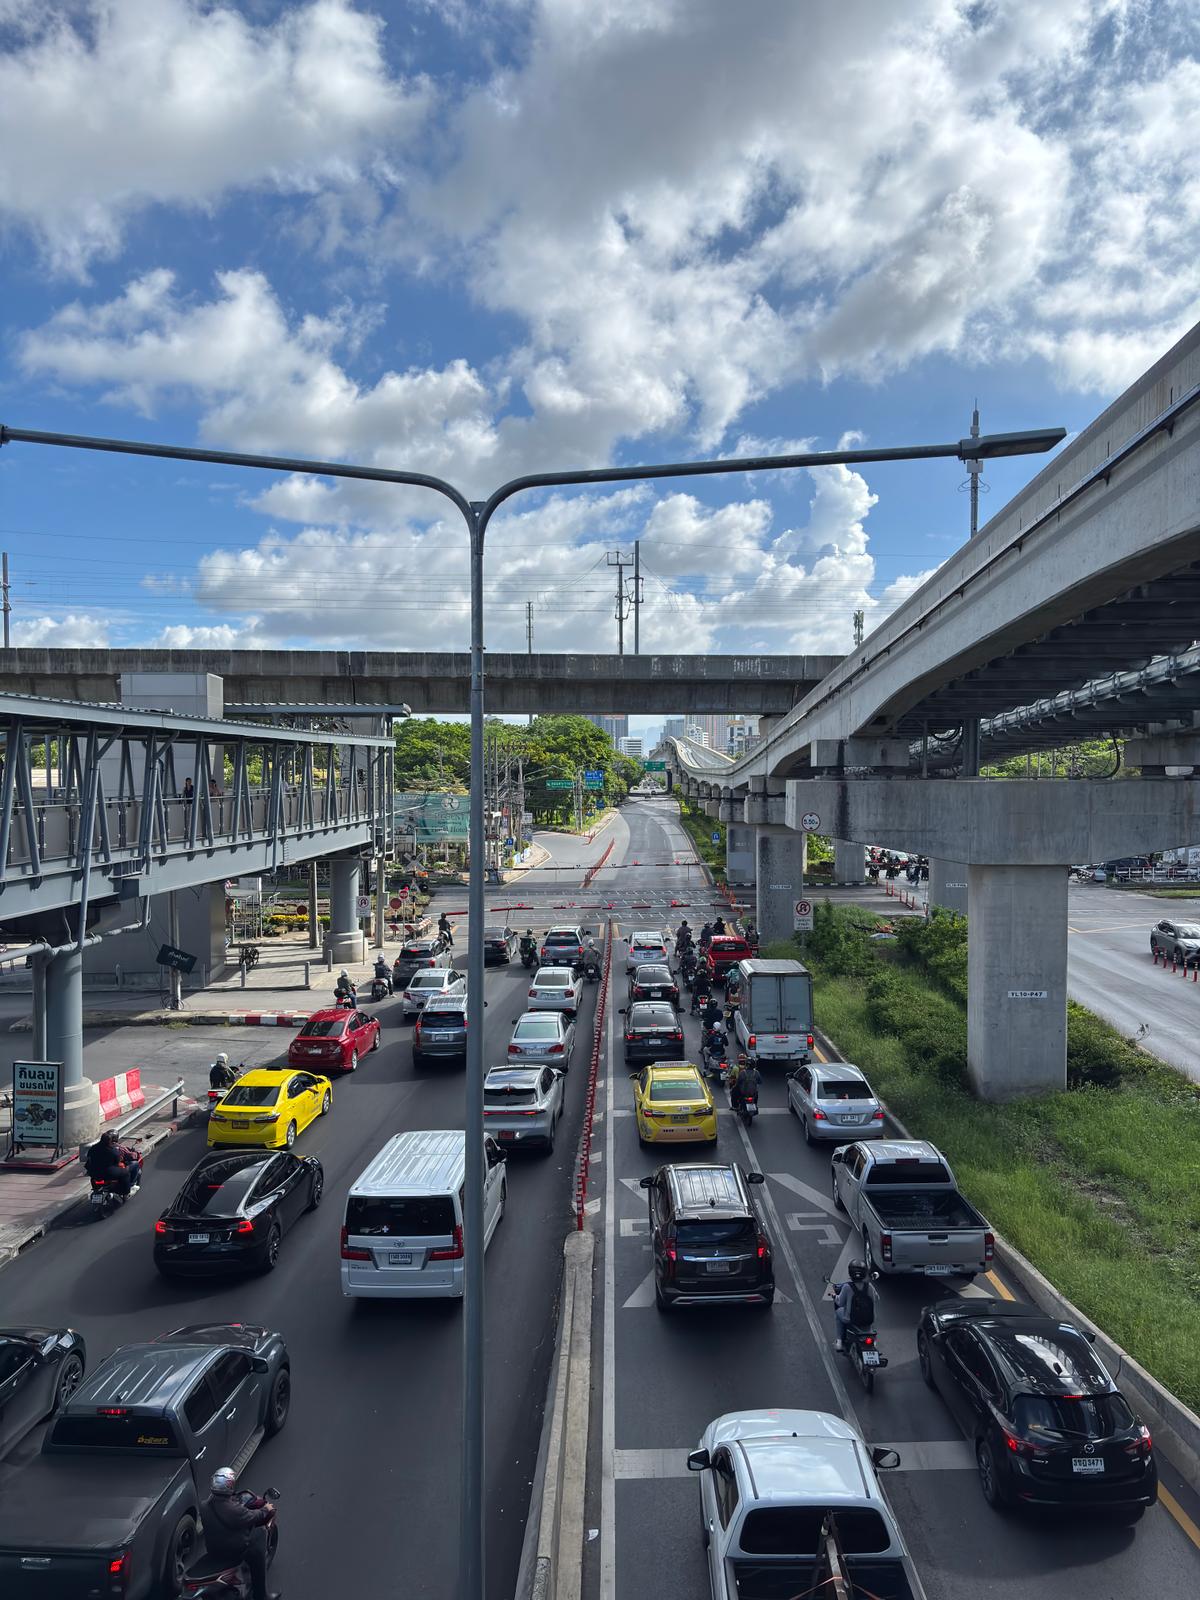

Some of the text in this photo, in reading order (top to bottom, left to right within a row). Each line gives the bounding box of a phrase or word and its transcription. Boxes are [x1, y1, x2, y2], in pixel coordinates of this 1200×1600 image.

[19, 1067, 55, 1081] กินลม
[19, 1080, 55, 1091] ชมรถไฟ
